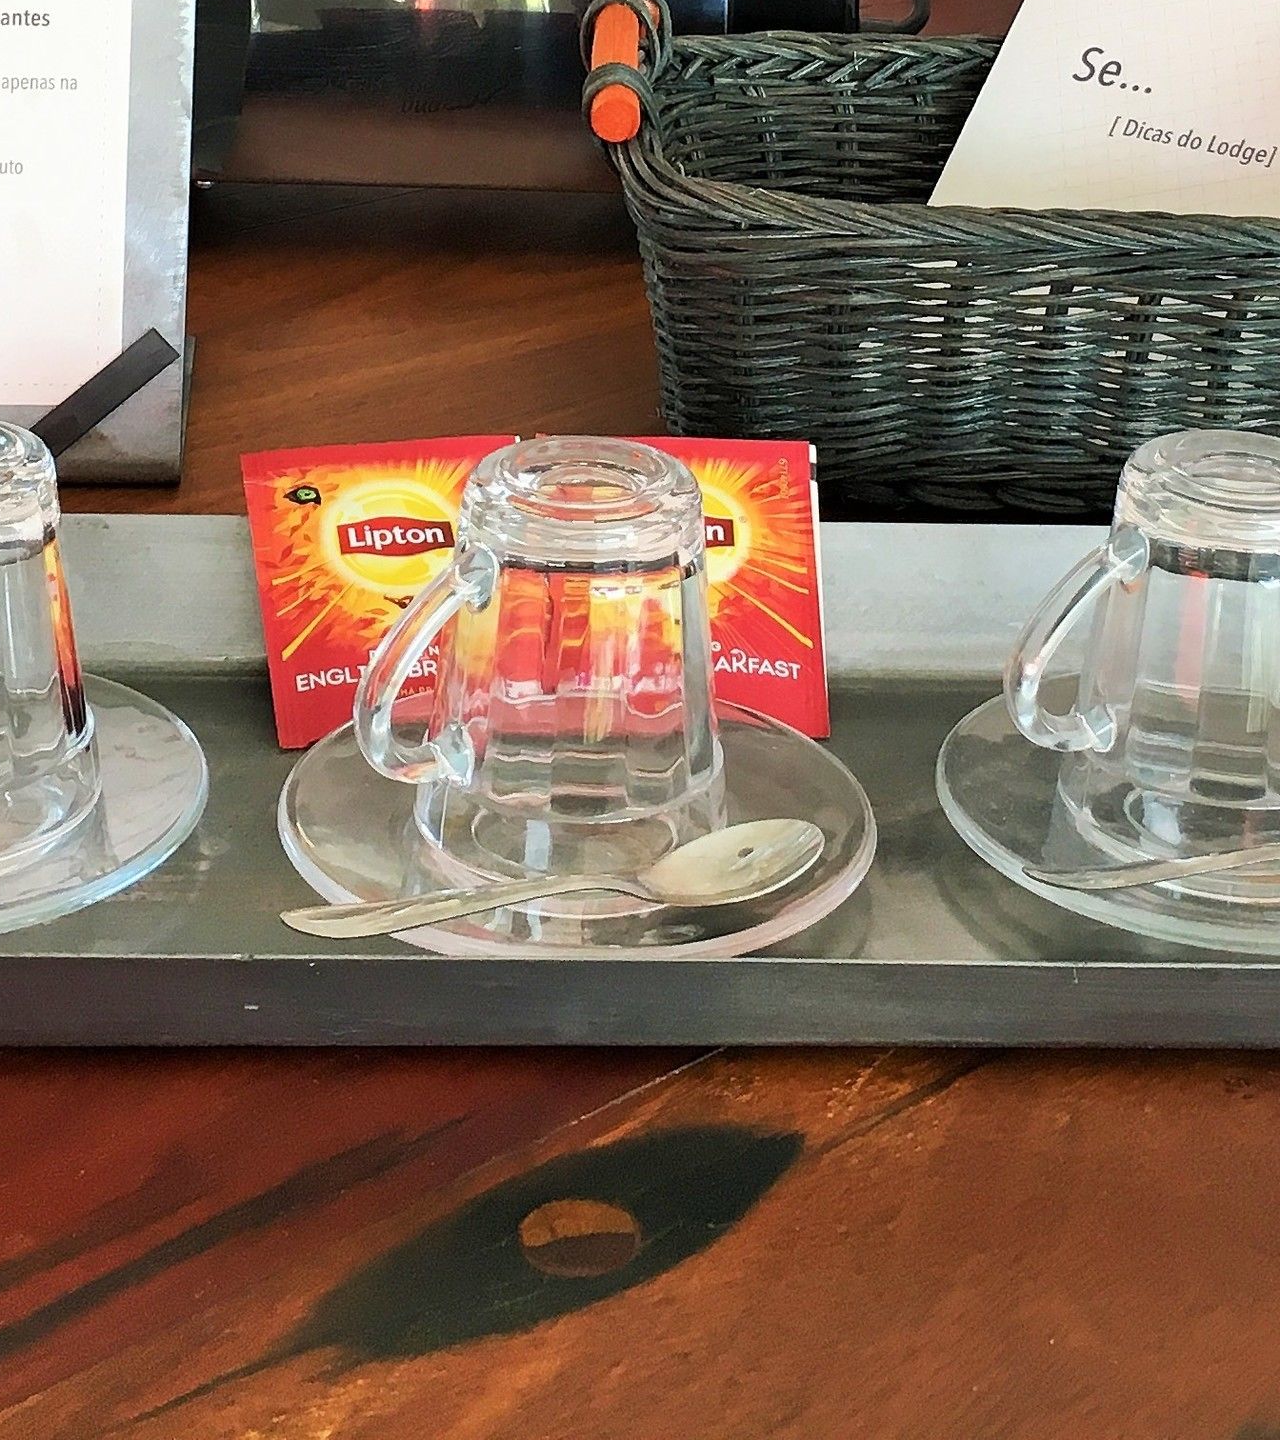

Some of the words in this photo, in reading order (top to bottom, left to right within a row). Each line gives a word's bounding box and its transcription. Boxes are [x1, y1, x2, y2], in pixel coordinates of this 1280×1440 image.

[1, 77, 55, 93] apenas
[60, 77, 77, 90] na
[1072, 46, 1154, 95] Se...
[1177, 127, 1203, 151] do
[1207, 133, 1278, 168] Lodge]
[348, 523, 446, 553] Lipton
